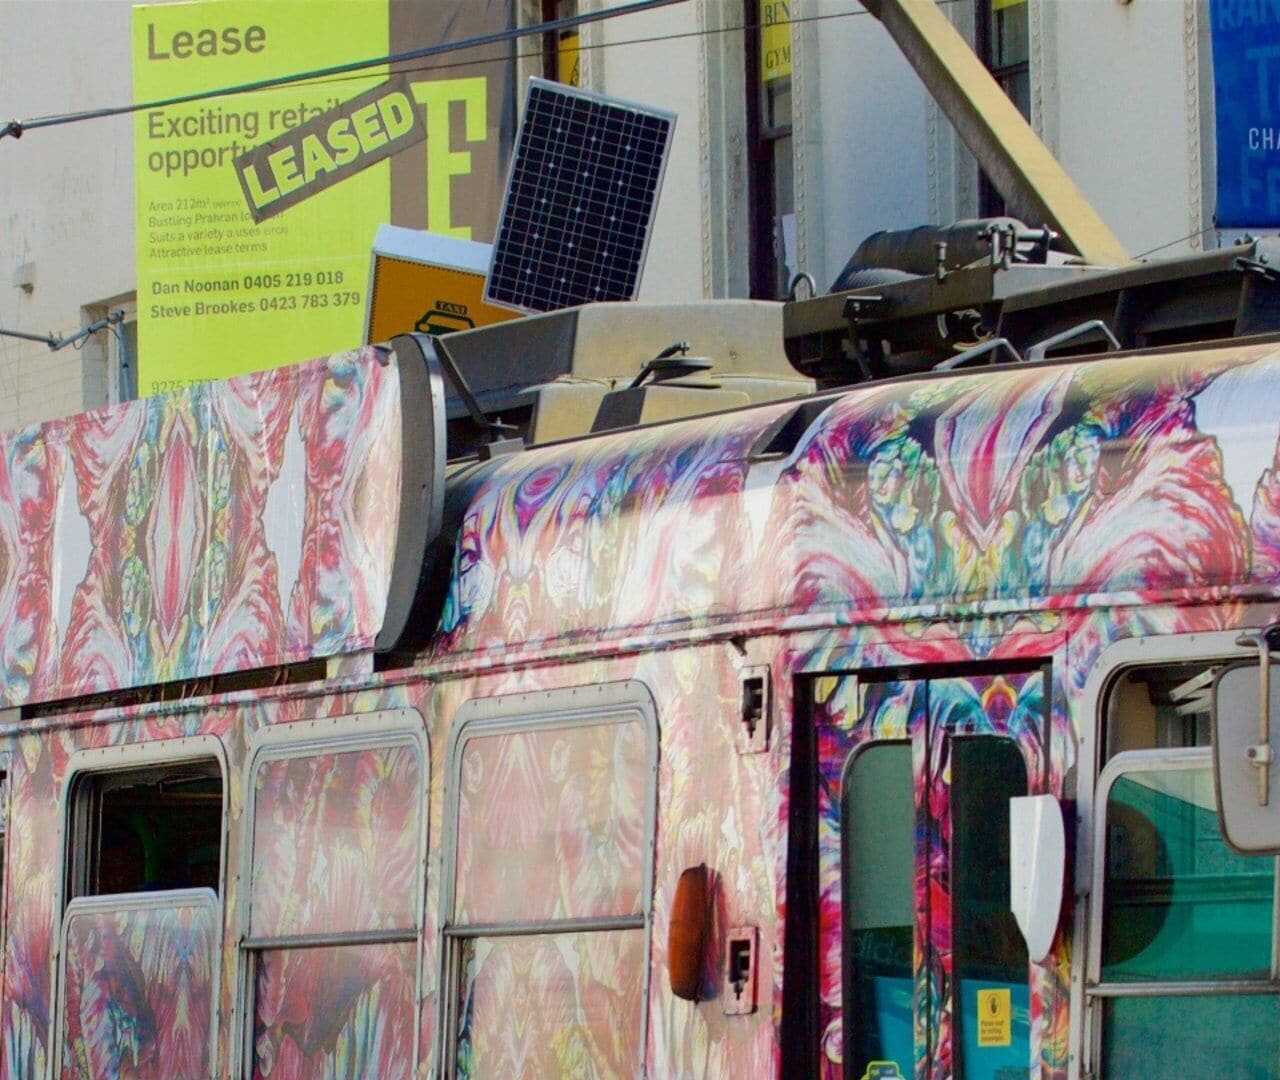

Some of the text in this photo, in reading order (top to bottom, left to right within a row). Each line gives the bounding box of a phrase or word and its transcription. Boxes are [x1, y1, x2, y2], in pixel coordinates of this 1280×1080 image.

[147, 23, 266, 60] Lease
[148, 108, 259, 139] Exciting
[243, 92, 414, 208] LEASED
[149, 202, 173, 212] Area
[149, 216, 192, 228] Bustling
[195, 213, 238, 225] Prahran
[149, 232, 175, 244] Suits
[187, 229, 224, 245] variety
[235, 228, 261, 237] uses
[150, 243, 268, 260] Attractive lease terms
[152, 271, 343, 295] Dan Noonan 0405 219 018
[151, 292, 361, 318] Steve Brookes 0423 783 379
[439, 302, 467, 315] TAXI
